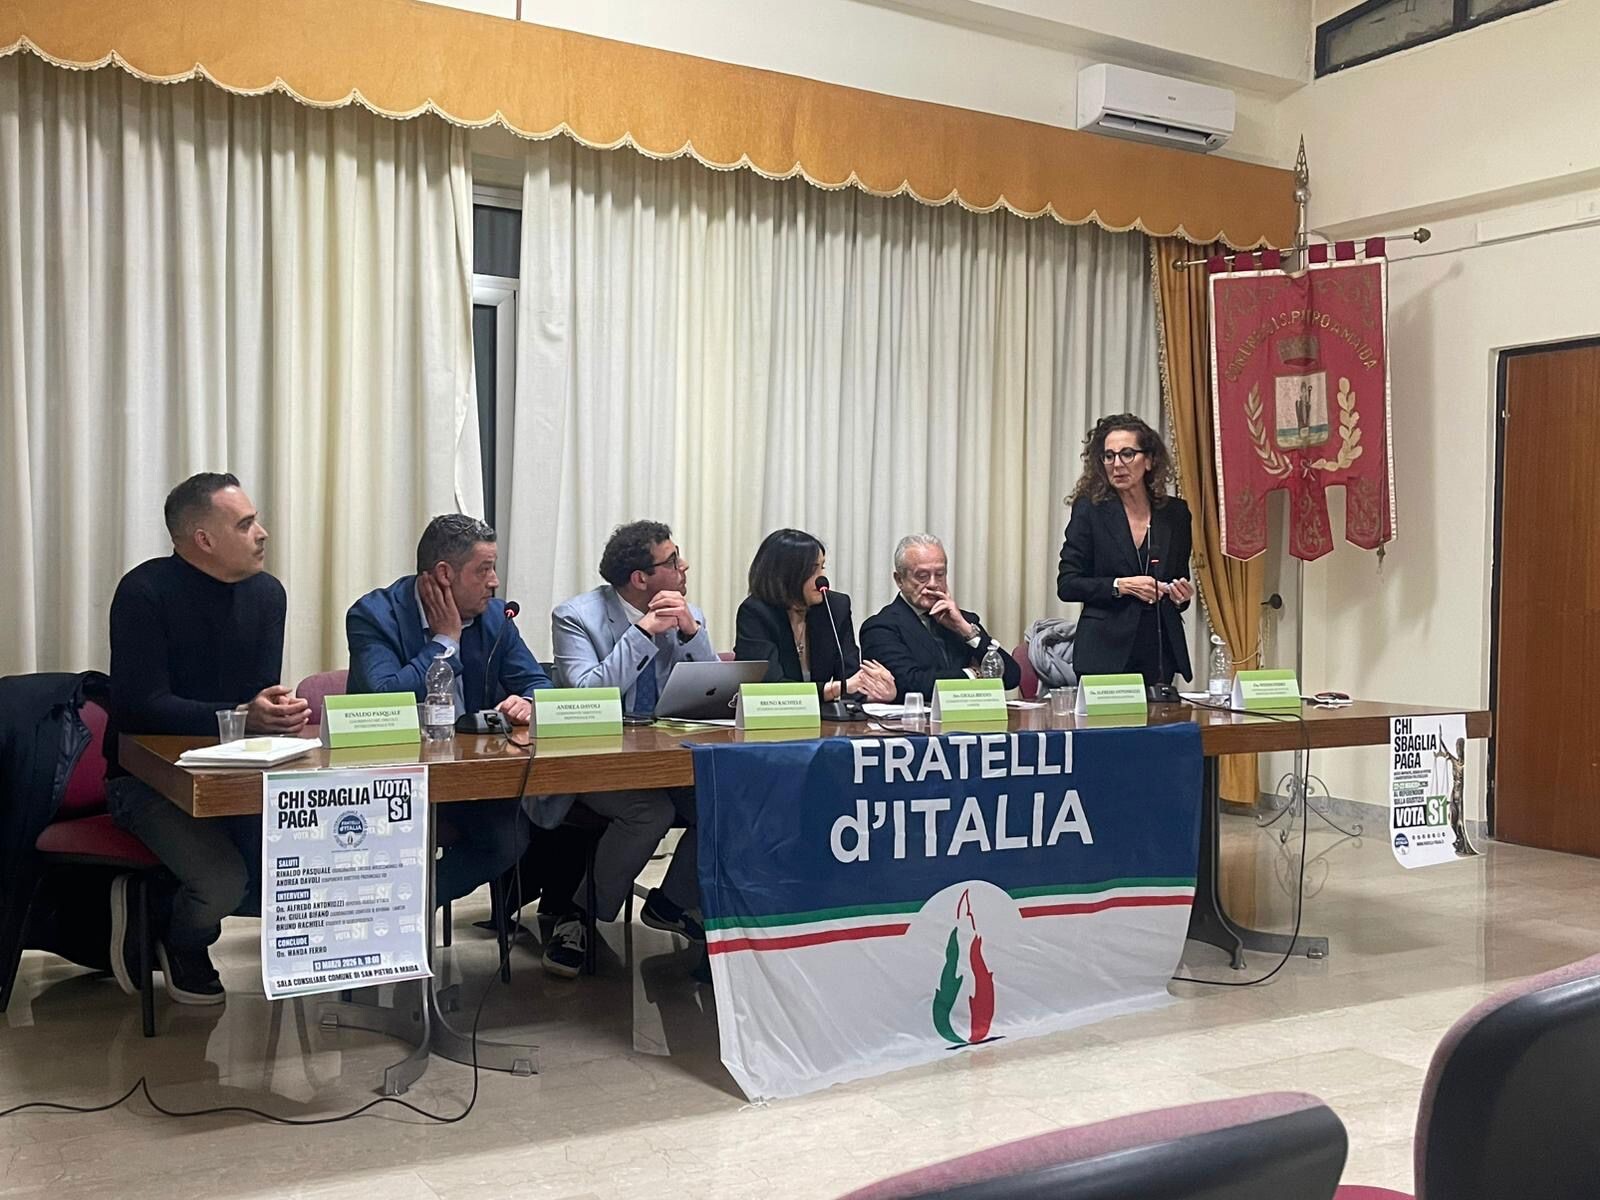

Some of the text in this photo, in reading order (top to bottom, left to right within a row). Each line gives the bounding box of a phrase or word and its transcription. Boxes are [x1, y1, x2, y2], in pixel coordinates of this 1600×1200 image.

[1394, 718, 1412, 735] CHI
[1394, 734, 1436, 752] SBAGLIA
[852, 731, 1073, 784] FRATELLI
[1394, 752, 1421, 770] PAGA
[278, 780, 411, 810] CHI SBAGLIA VOTA
[278, 810, 318, 829] PAGA
[1396, 807, 1426, 827] VOTA
[829, 790, 1093, 863] d'ITALIA
[278, 859, 298, 868] SALUTI
[276, 868, 301, 878] RINALDO
[302, 867, 331, 876] PASQUALE
[276, 877, 299, 886] ANDREA
[300, 876, 320, 885] DAVOLI
[277, 891, 309, 901] INTERVENTI
[287, 903, 312, 912] ALFREDO
[288, 912, 308, 920] GIULIA
[276, 923, 296, 931] BRUNO
[297, 920, 324, 929] RACHIELE
[277, 937, 308, 947] CONCLUDE
[288, 948, 307, 956] WANDA
[309, 946, 327, 954] FERRO
[276, 979, 292, 988] SALA
[293, 975, 326, 986] CONSILIARE
[328, 972, 353, 981] COMUNE
[361, 970, 373, 978] SAN
[374, 968, 393, 977] PIETRO
[400, 964, 419, 973] MAIDA
